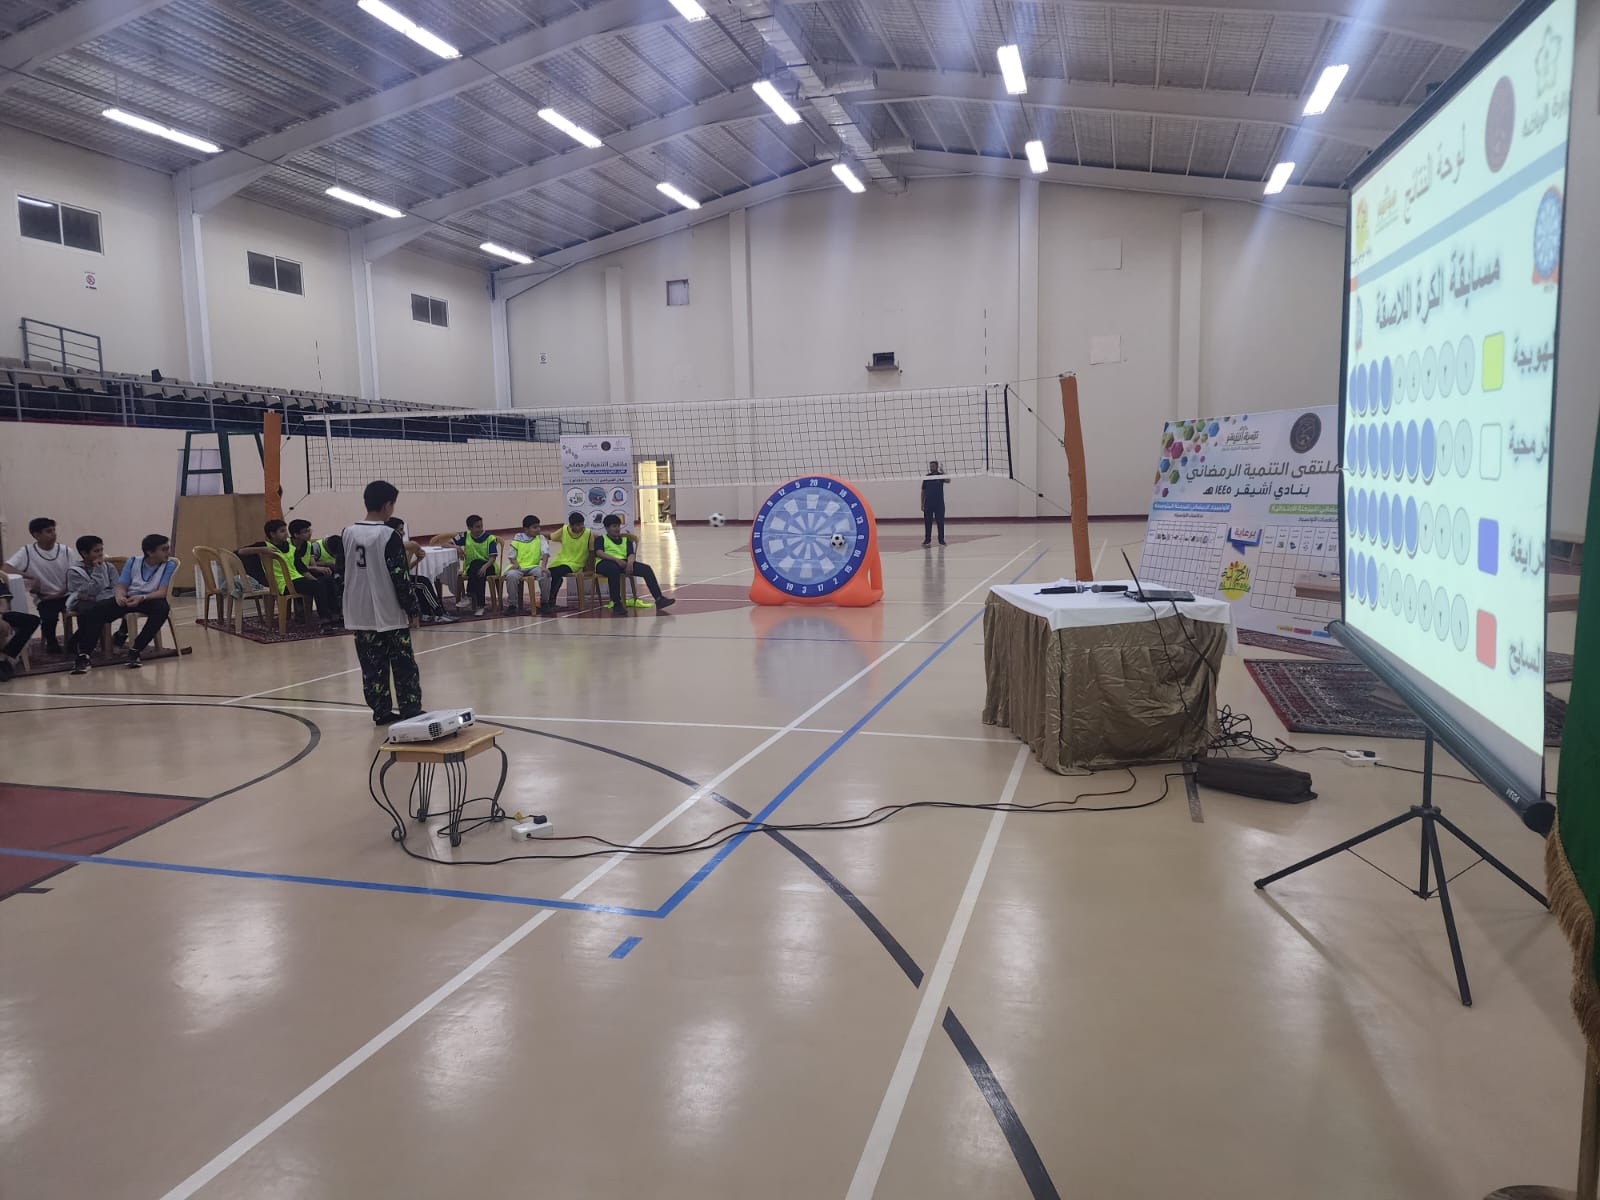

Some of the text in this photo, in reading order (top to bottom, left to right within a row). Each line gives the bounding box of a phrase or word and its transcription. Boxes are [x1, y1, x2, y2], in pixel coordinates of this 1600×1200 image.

[1403, 121, 1466, 225] لوحة النتائج
[1375, 249, 1500, 329] مسابقة الكرة اللاصقة
[1509, 424, 1549, 463] لرمحية
[1186, 460, 1338, 483] ملتقى التنمية الرمضاني
[810, 479, 818, 487] 20
[1234, 482, 1272, 497] أشيقر
[778, 488, 786, 497] 12
[1274, 484, 1310, 500] بنادي
[355, 545, 367, 568] 3
[786, 582, 794, 591] 19
[832, 577, 839, 585] 2
[801, 586, 807, 594] 3
